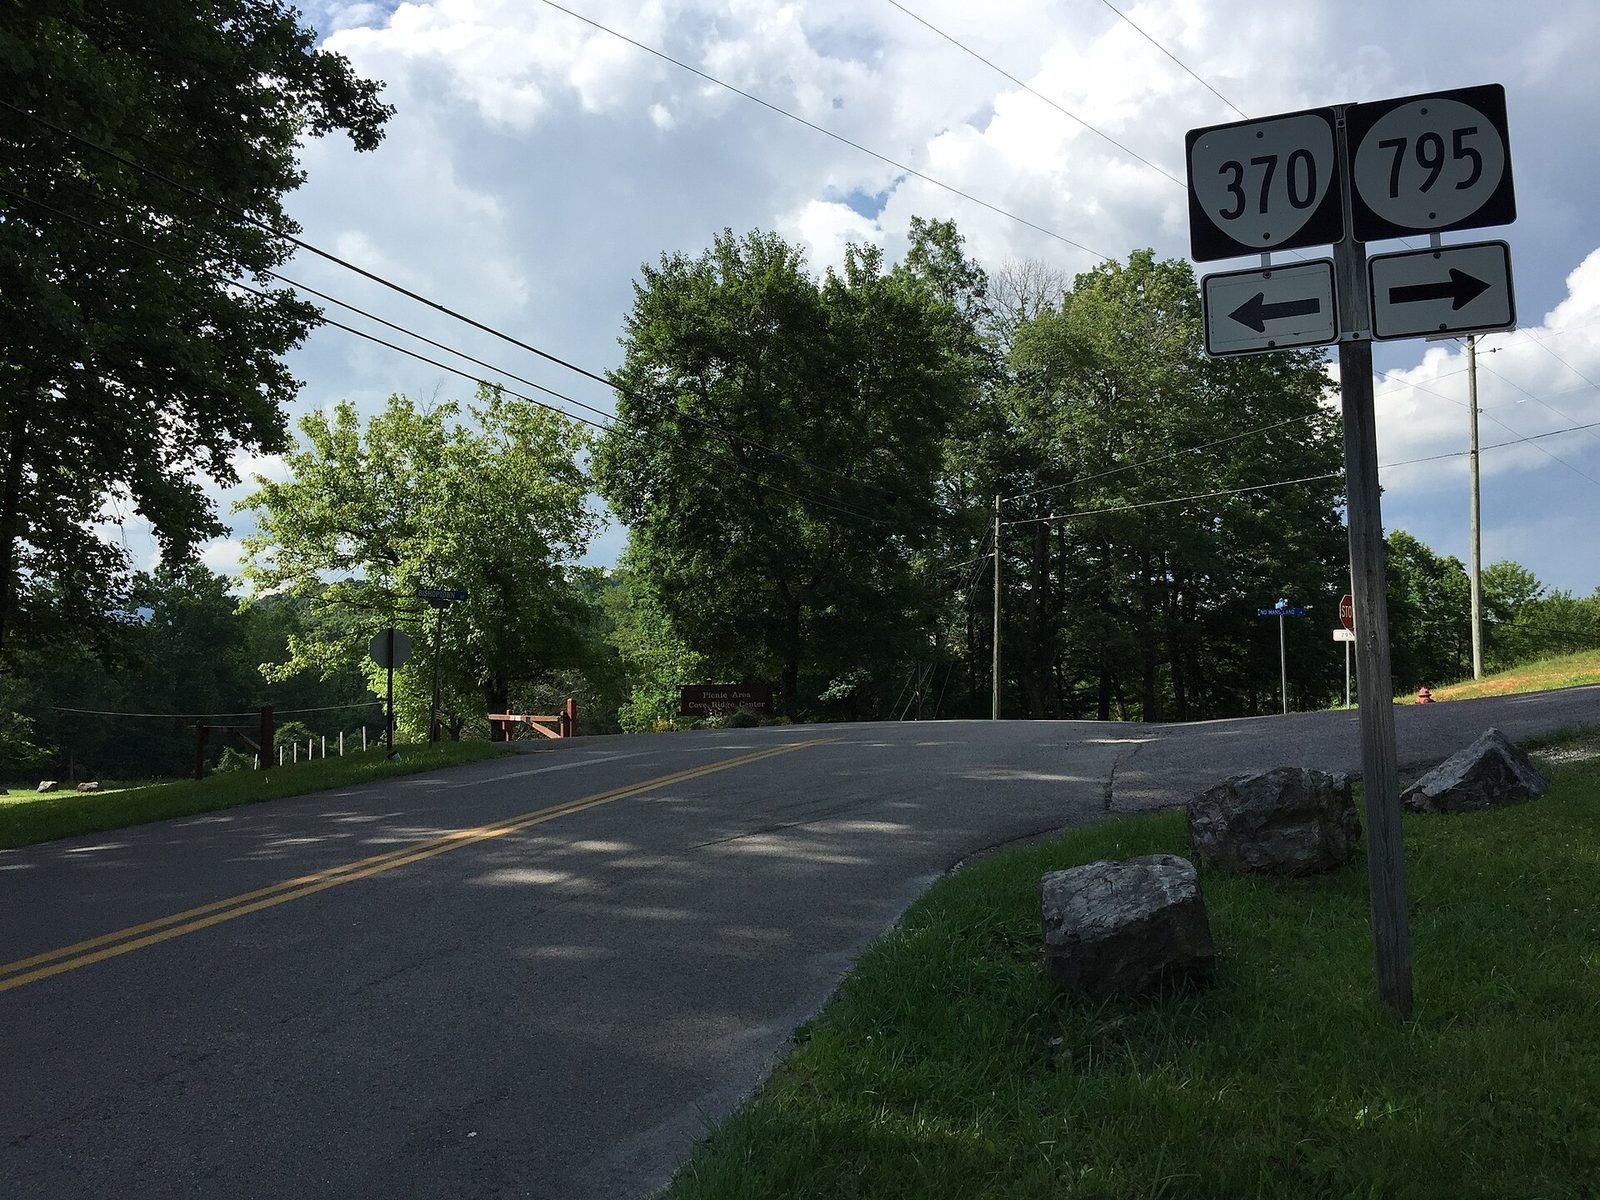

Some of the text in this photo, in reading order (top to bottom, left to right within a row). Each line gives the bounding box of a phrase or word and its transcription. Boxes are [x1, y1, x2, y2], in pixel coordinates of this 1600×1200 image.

[1378, 126, 1483, 199] 795
[1218, 149, 1317, 221] 370
[1341, 605, 1353, 618] STO
[702, 691, 751, 699] Picnic Area
[688, 701, 708, 709] Cove
[711, 701, 735, 710] Ridge
